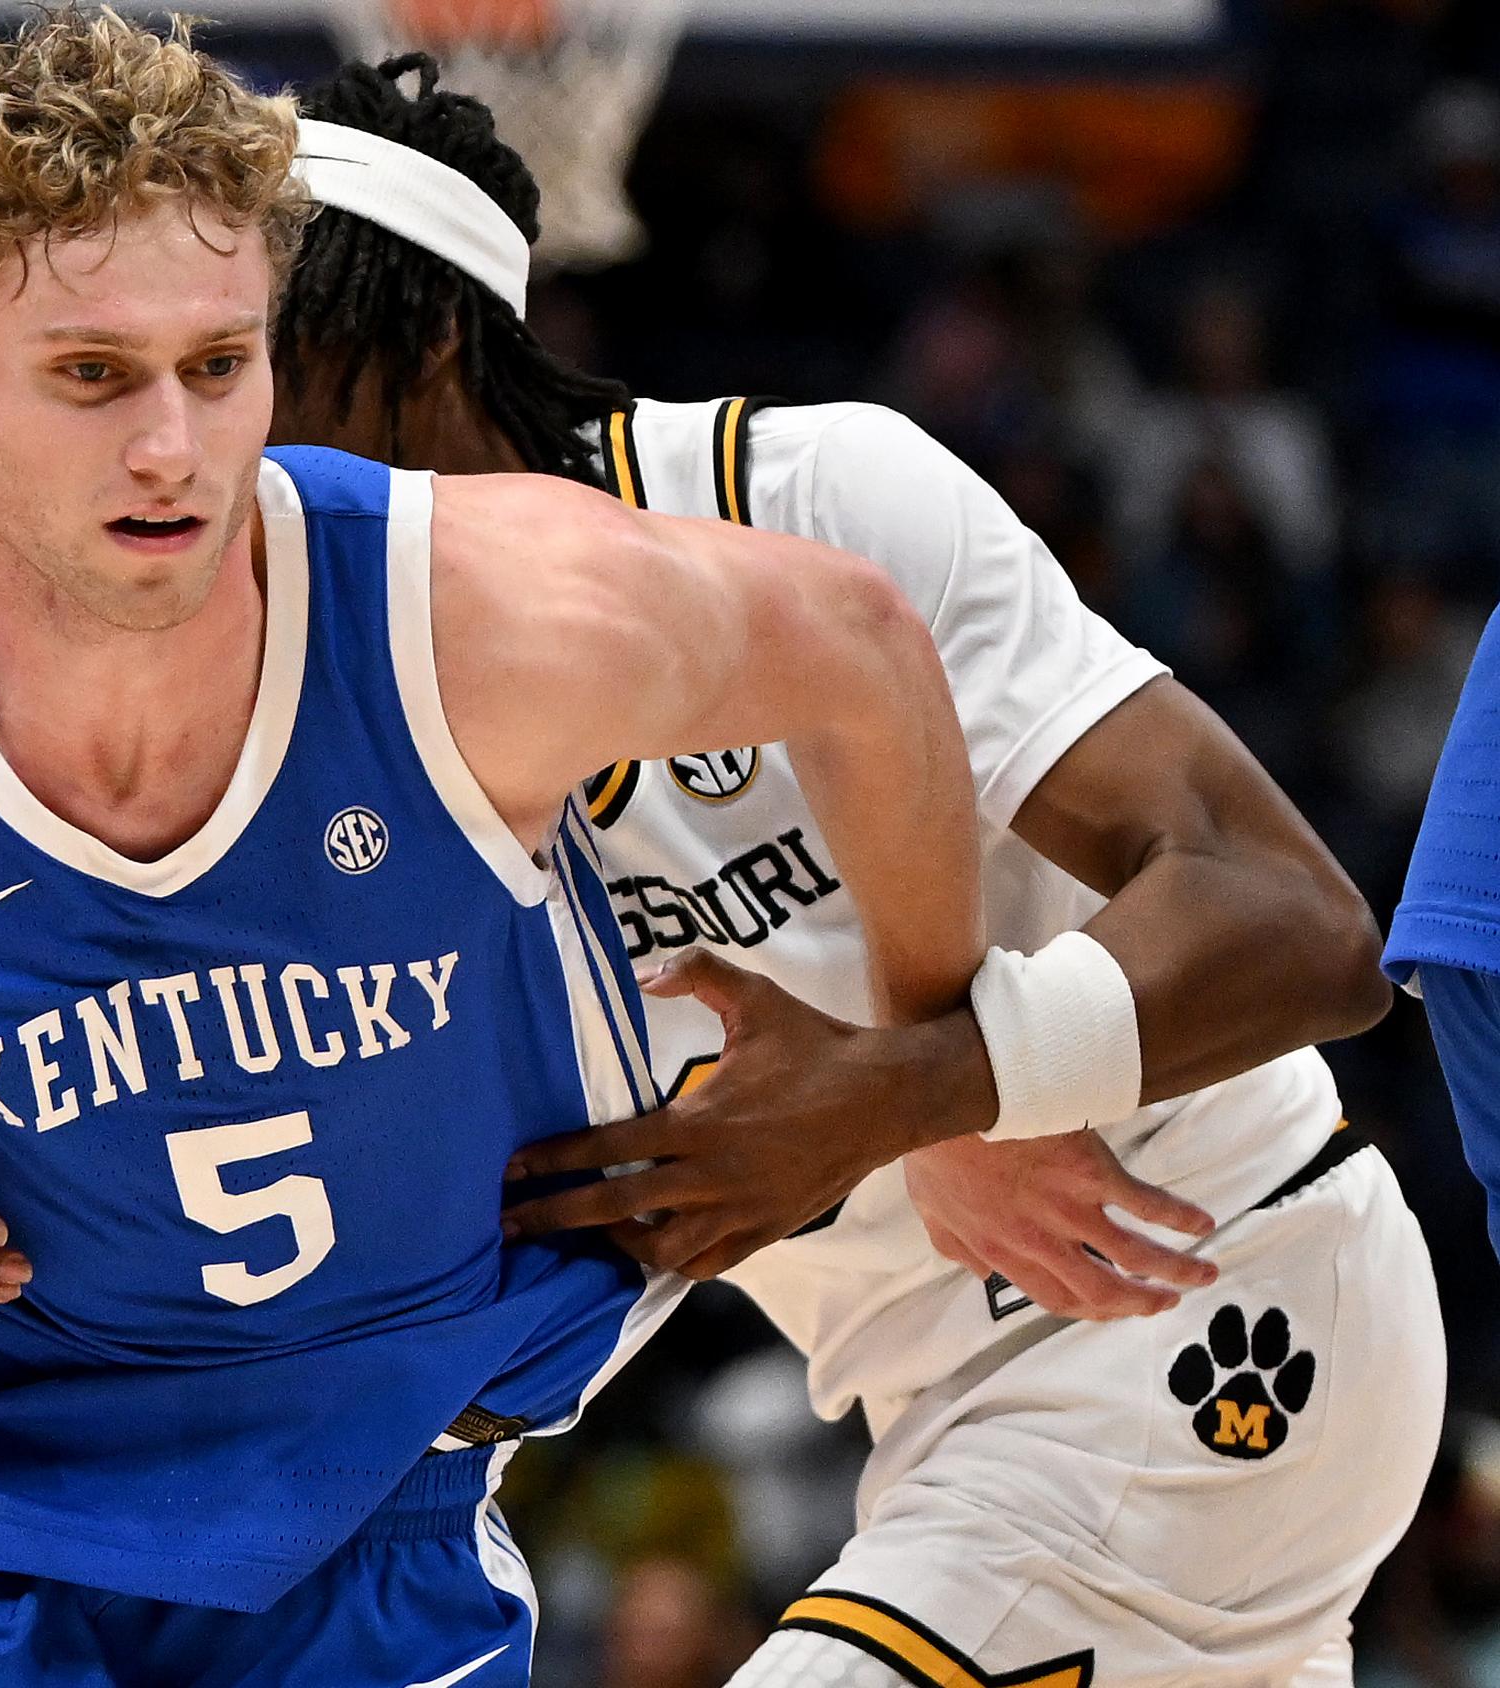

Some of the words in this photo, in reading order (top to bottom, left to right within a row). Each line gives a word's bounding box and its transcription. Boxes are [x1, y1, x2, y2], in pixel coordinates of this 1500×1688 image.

[329, 812, 383, 869] SEC
[165, 1110, 336, 1307] 5
[1213, 1398, 1271, 1450] M
